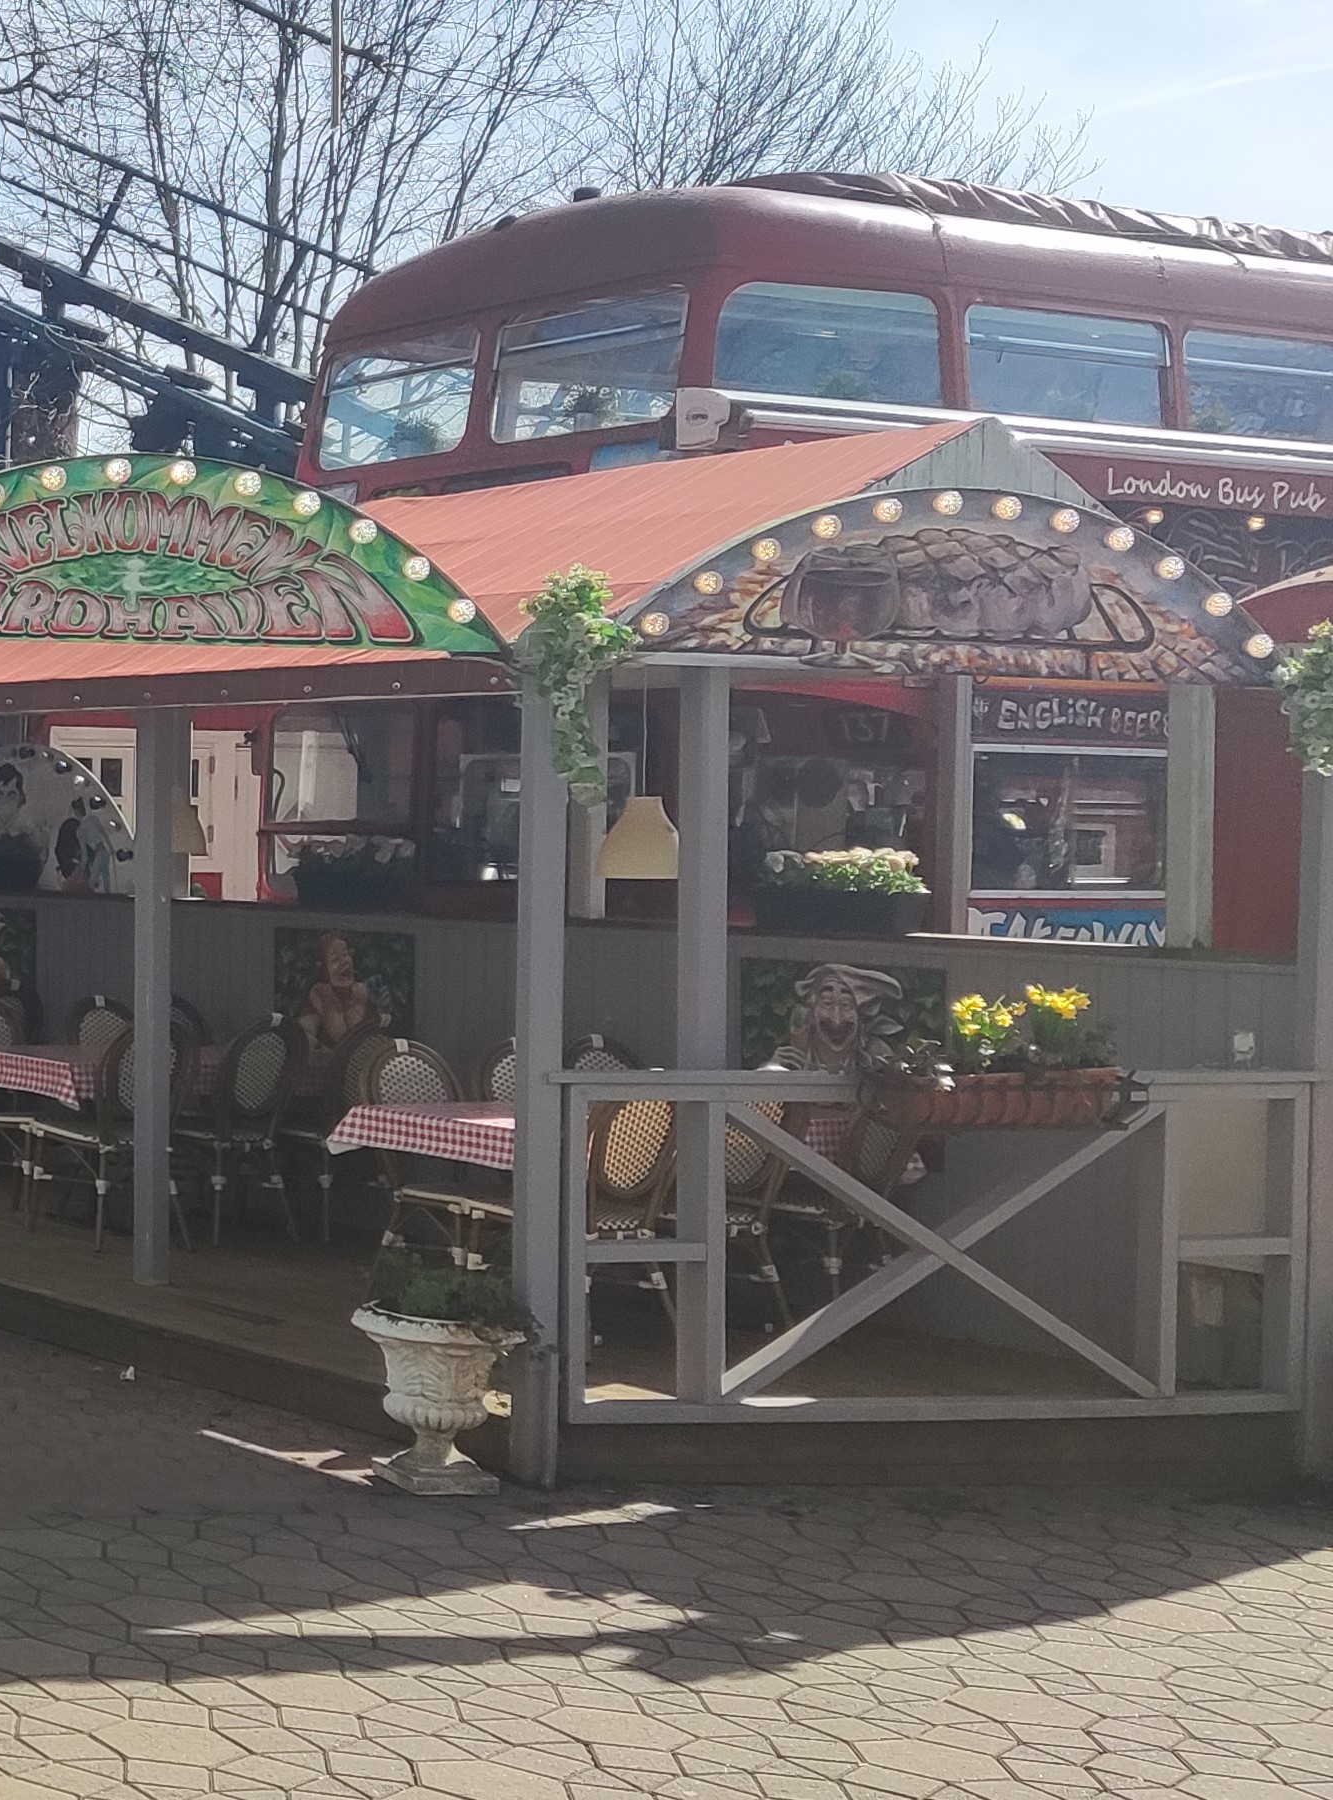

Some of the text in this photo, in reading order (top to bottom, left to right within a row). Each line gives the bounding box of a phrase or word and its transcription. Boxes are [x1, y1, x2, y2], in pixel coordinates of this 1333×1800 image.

[1107, 467, 1327, 512] London Bus Pub
